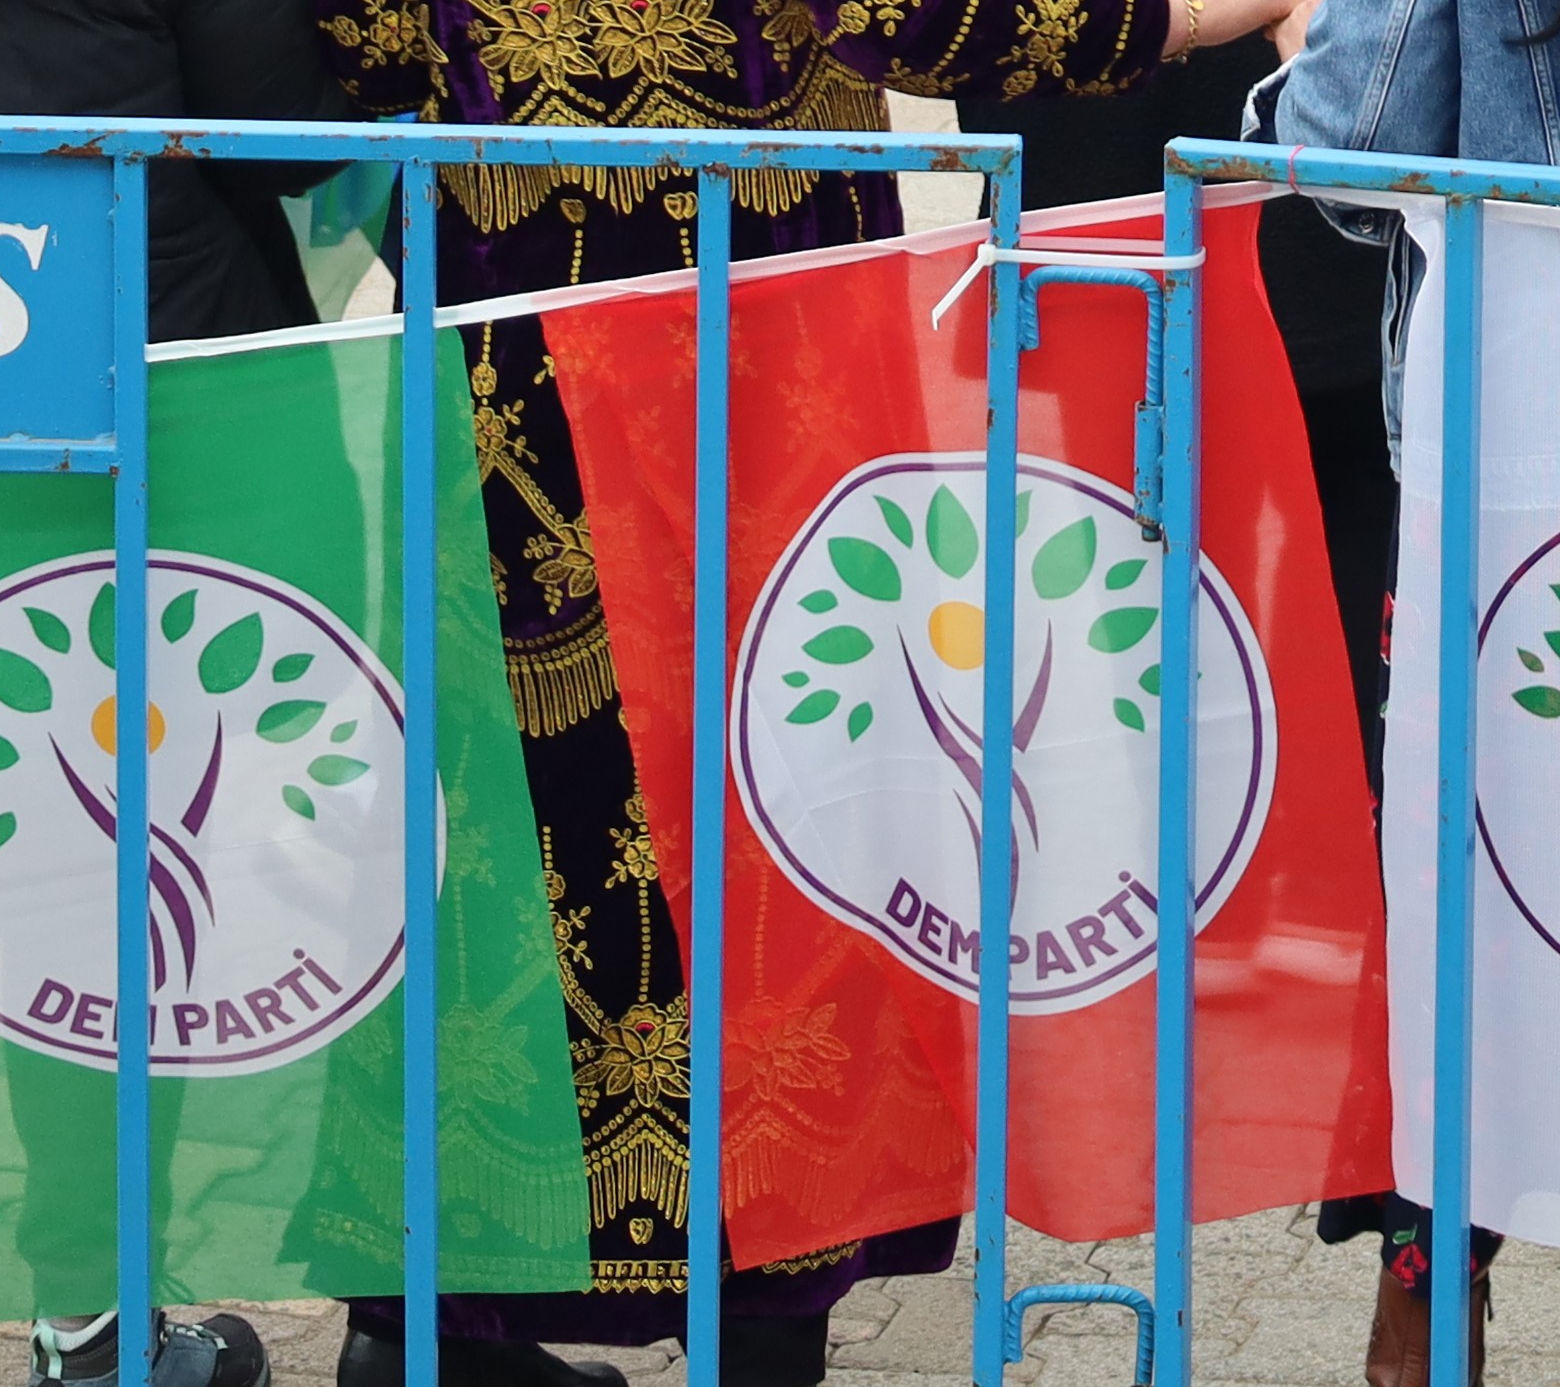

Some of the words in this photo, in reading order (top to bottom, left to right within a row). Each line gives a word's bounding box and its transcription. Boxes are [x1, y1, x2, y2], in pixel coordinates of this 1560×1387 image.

[885, 877, 981, 975] DEM
[1008, 870, 1159, 981] PARTİ
[172, 948, 344, 1047] PARTİ
